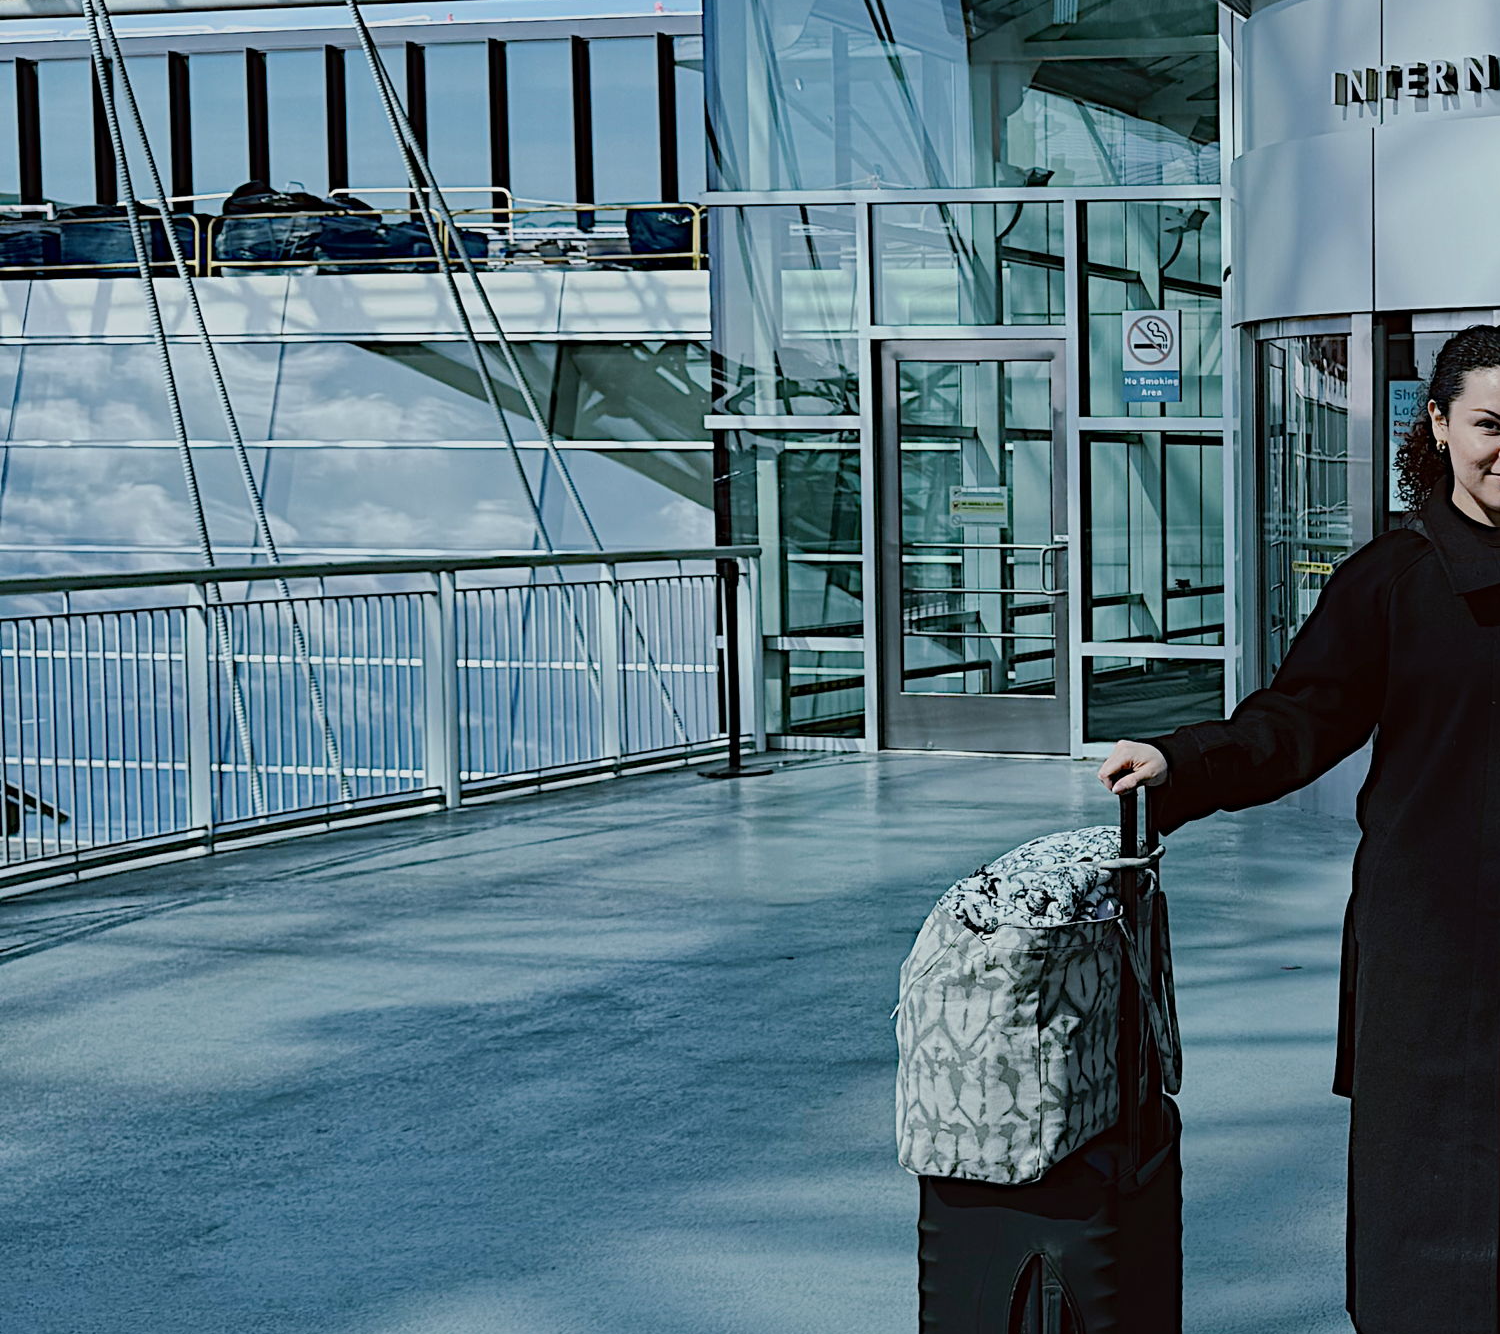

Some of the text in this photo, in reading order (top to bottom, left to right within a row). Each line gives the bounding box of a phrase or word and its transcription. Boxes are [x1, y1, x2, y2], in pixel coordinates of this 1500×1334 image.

[1124, 377, 1179, 387] No Smoking
[1141, 388, 1162, 396] Area
